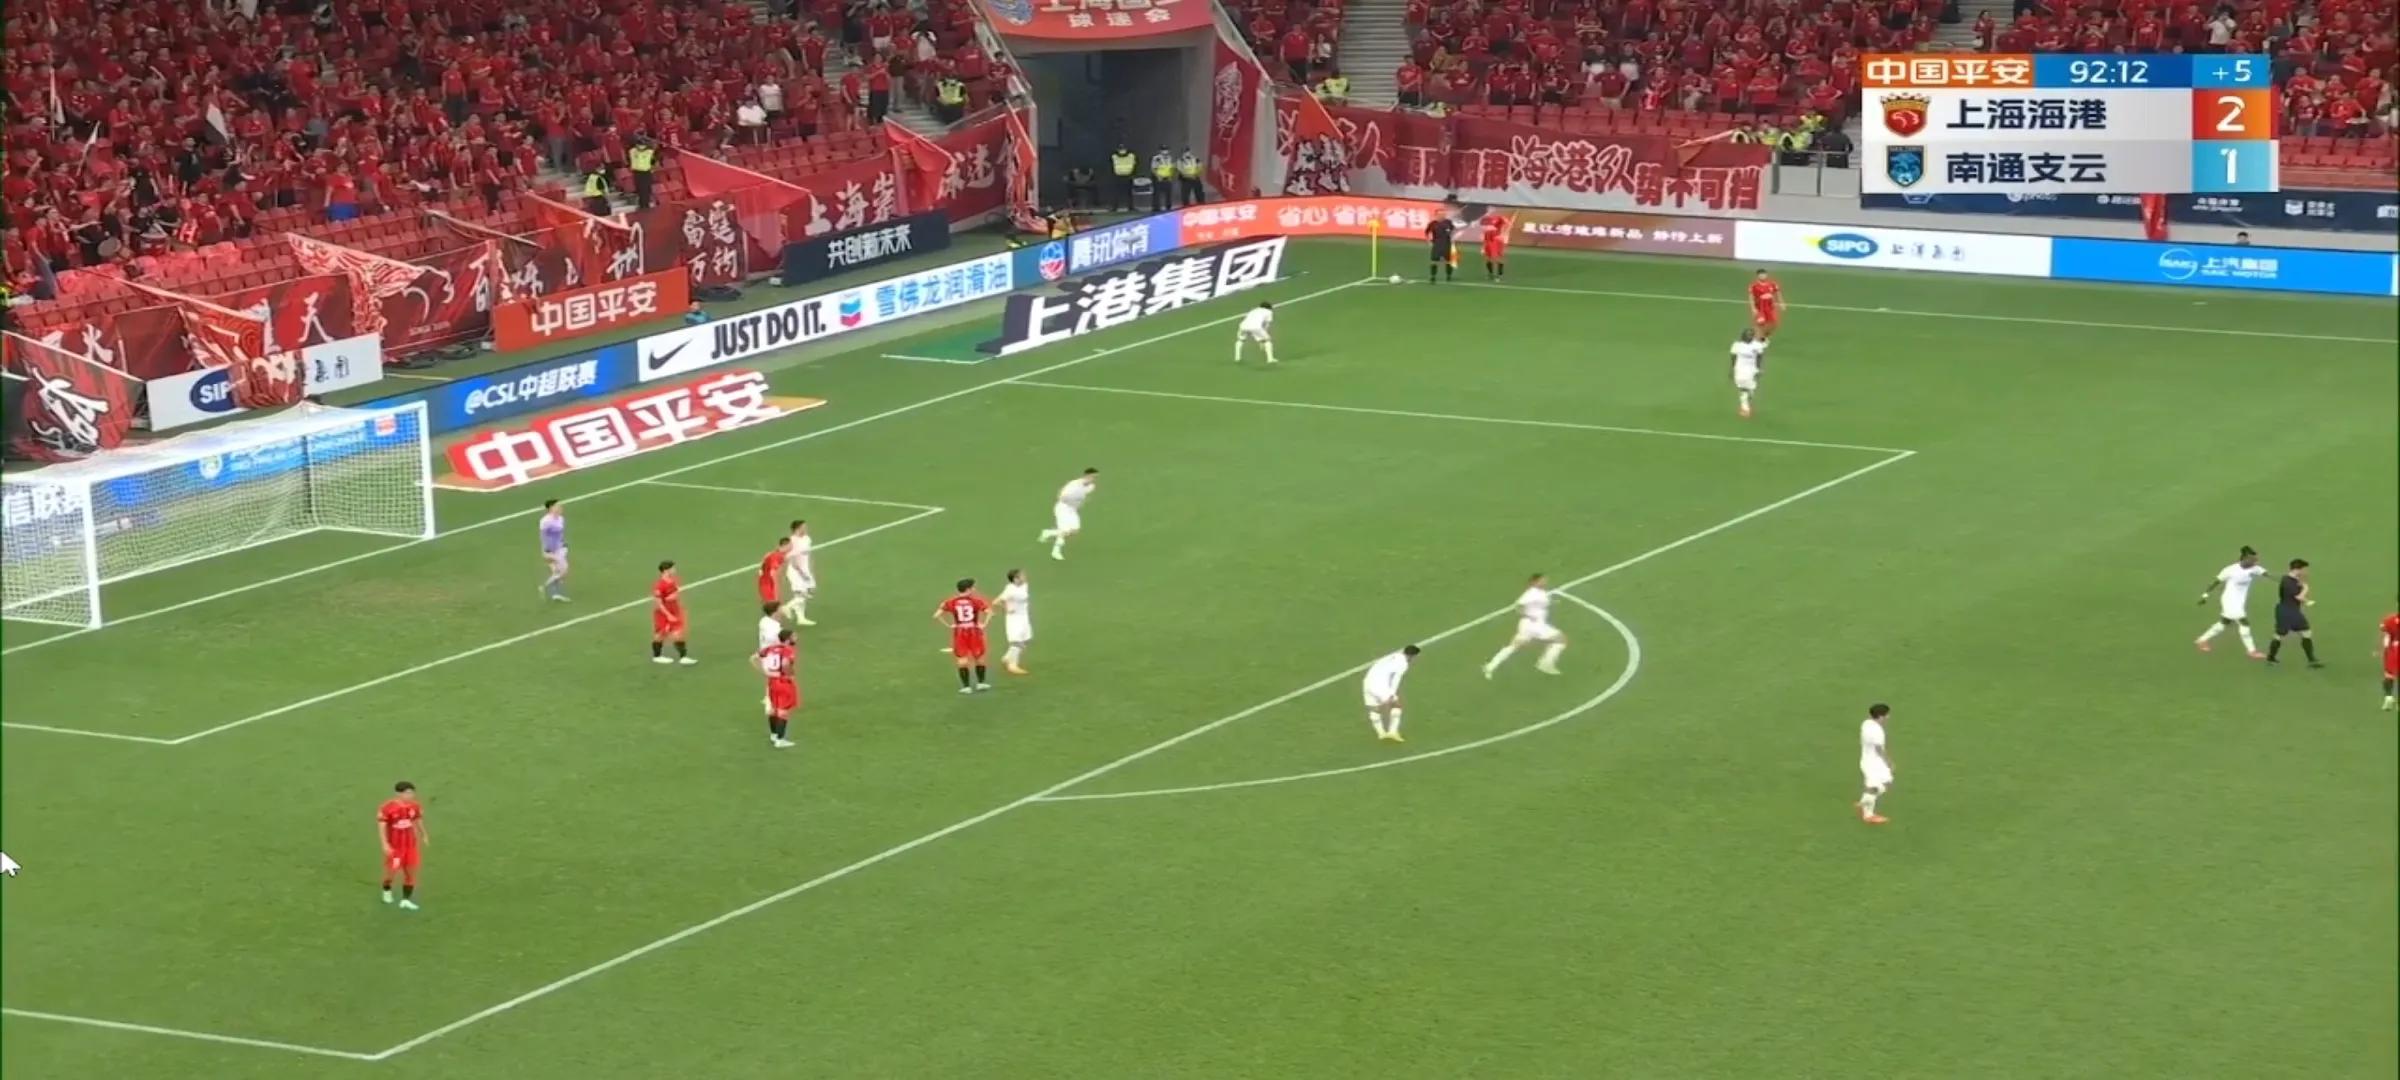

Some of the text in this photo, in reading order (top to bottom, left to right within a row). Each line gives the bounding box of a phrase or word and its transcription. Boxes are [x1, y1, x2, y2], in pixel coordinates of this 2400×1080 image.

[827, 224, 913, 269] 共创新未来
[1070, 223, 1151, 271] 腾讯体育
[1825, 239, 1872, 254] SIPG
[531, 281, 657, 336] 中国平安
[876, 259, 1008, 318] 雪佛龙润滑油
[998, 235, 1288, 357] 上港集团
[711, 301, 827, 360] JUST DO IT.
[464, 358, 600, 416] @CSL中超联赛
[464, 371, 782, 486] 中国平安
[954, 604, 975, 622] 13
